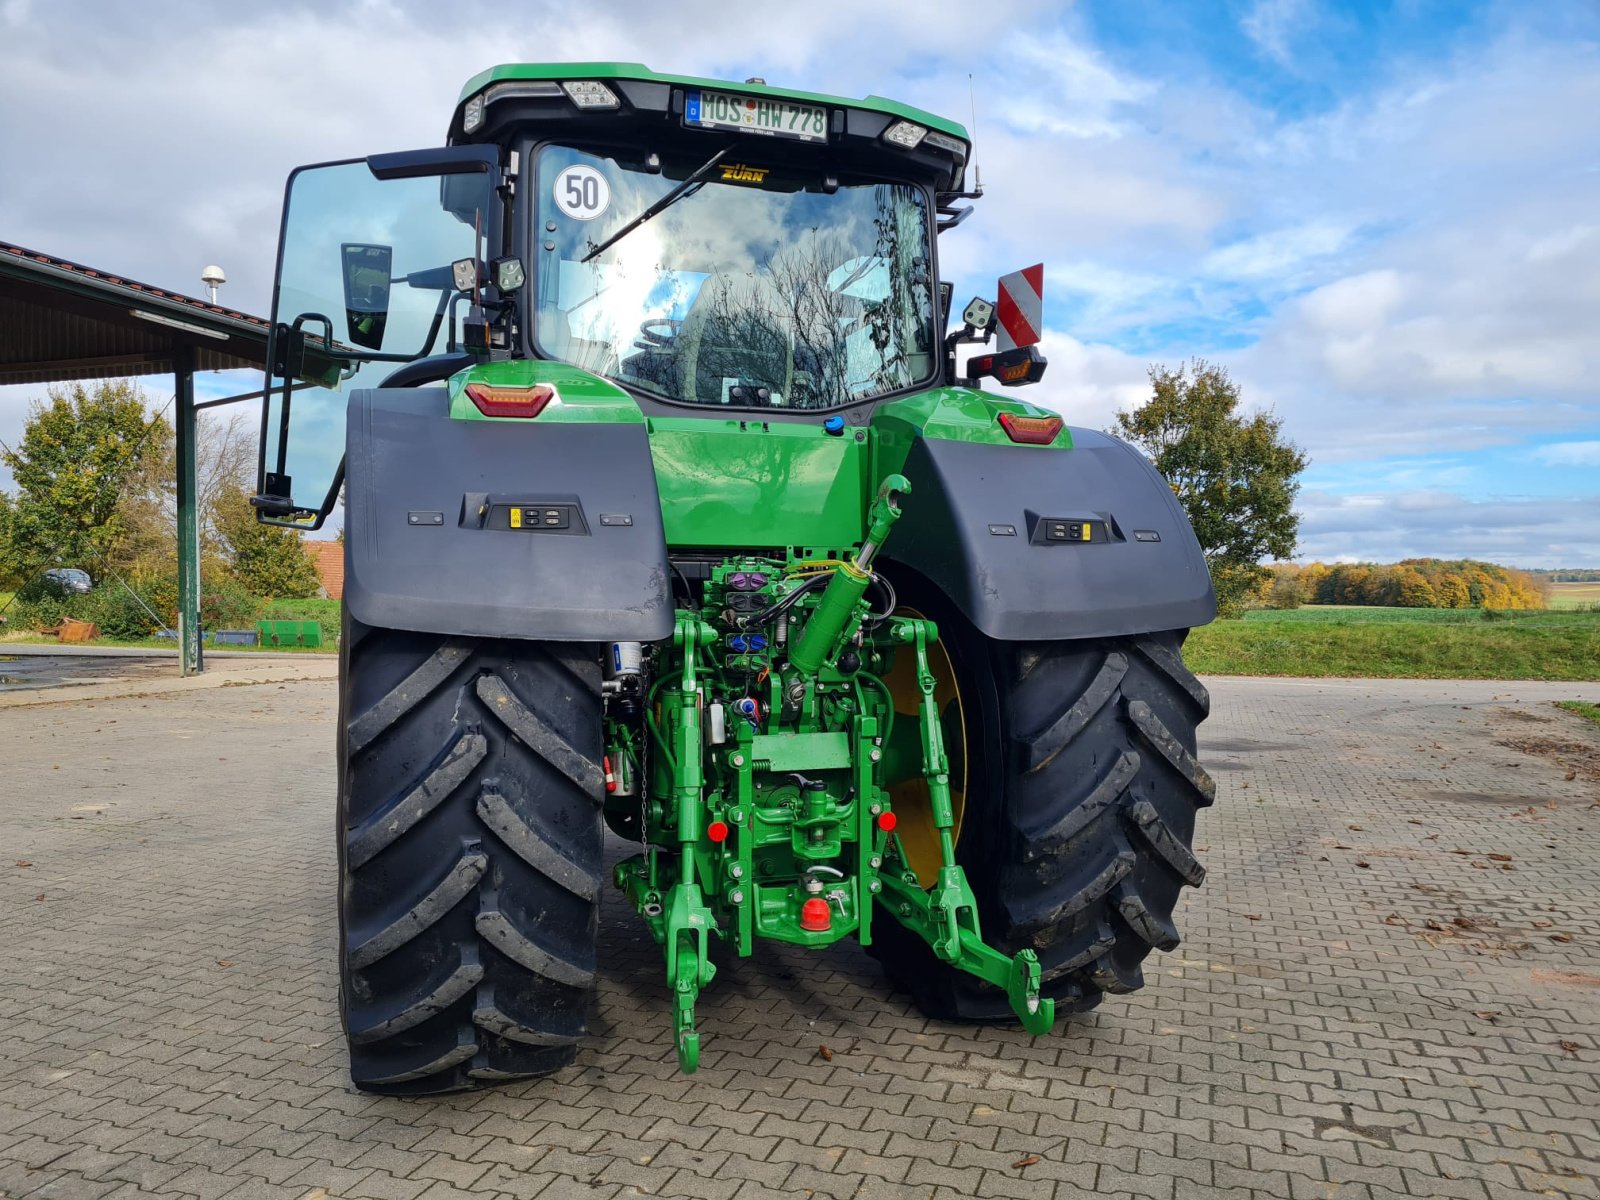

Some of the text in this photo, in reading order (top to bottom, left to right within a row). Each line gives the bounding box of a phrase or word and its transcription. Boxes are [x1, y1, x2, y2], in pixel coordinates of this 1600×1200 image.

[690, 107, 697, 116] D
[701, 93, 824, 134] MOS HW 778
[722, 163, 764, 182] ZÜRN
[566, 174, 599, 211] 50
